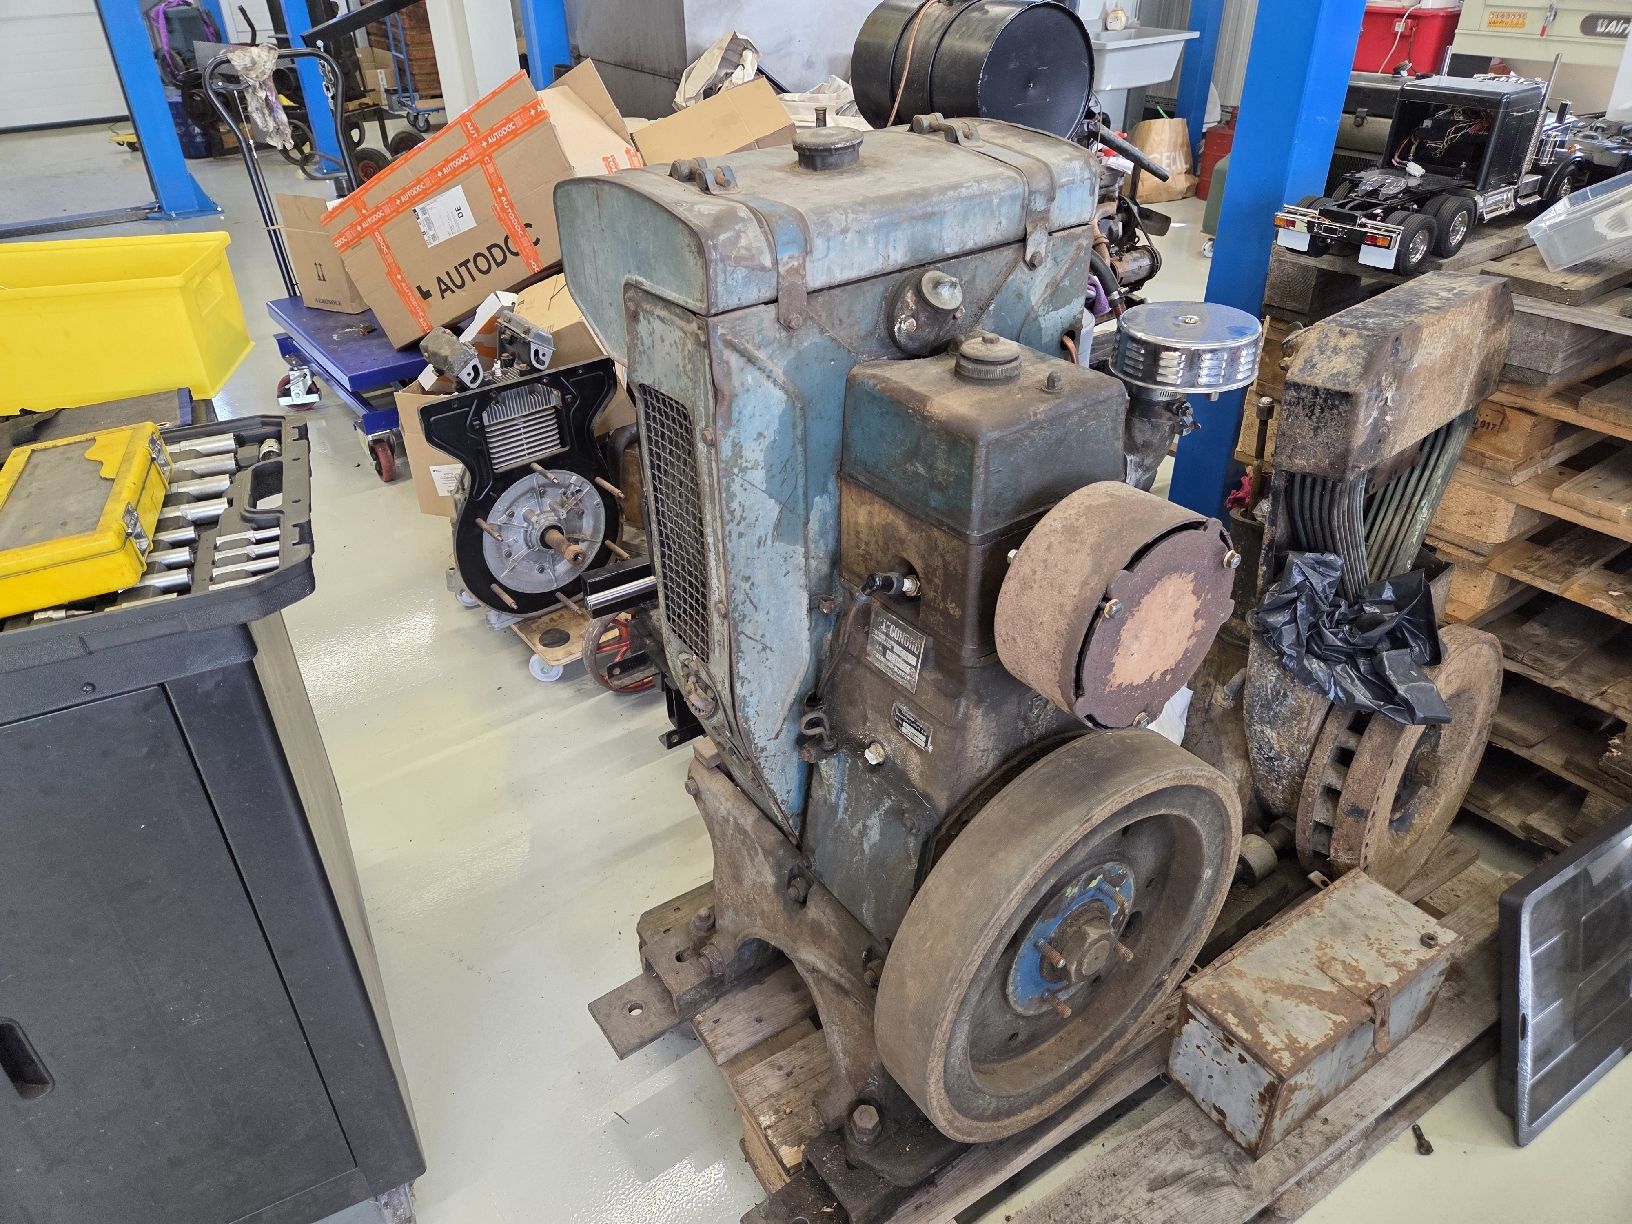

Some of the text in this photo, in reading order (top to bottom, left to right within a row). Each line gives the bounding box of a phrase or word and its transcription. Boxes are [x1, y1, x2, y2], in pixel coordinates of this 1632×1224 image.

[361, 210, 385, 229] AUTODOC
[401, 182, 426, 203] AUTODOC
[443, 153, 470, 174] AUTODOC
[487, 121, 516, 144] AUTODOC
[500, 196, 524, 238] AUTODOC
